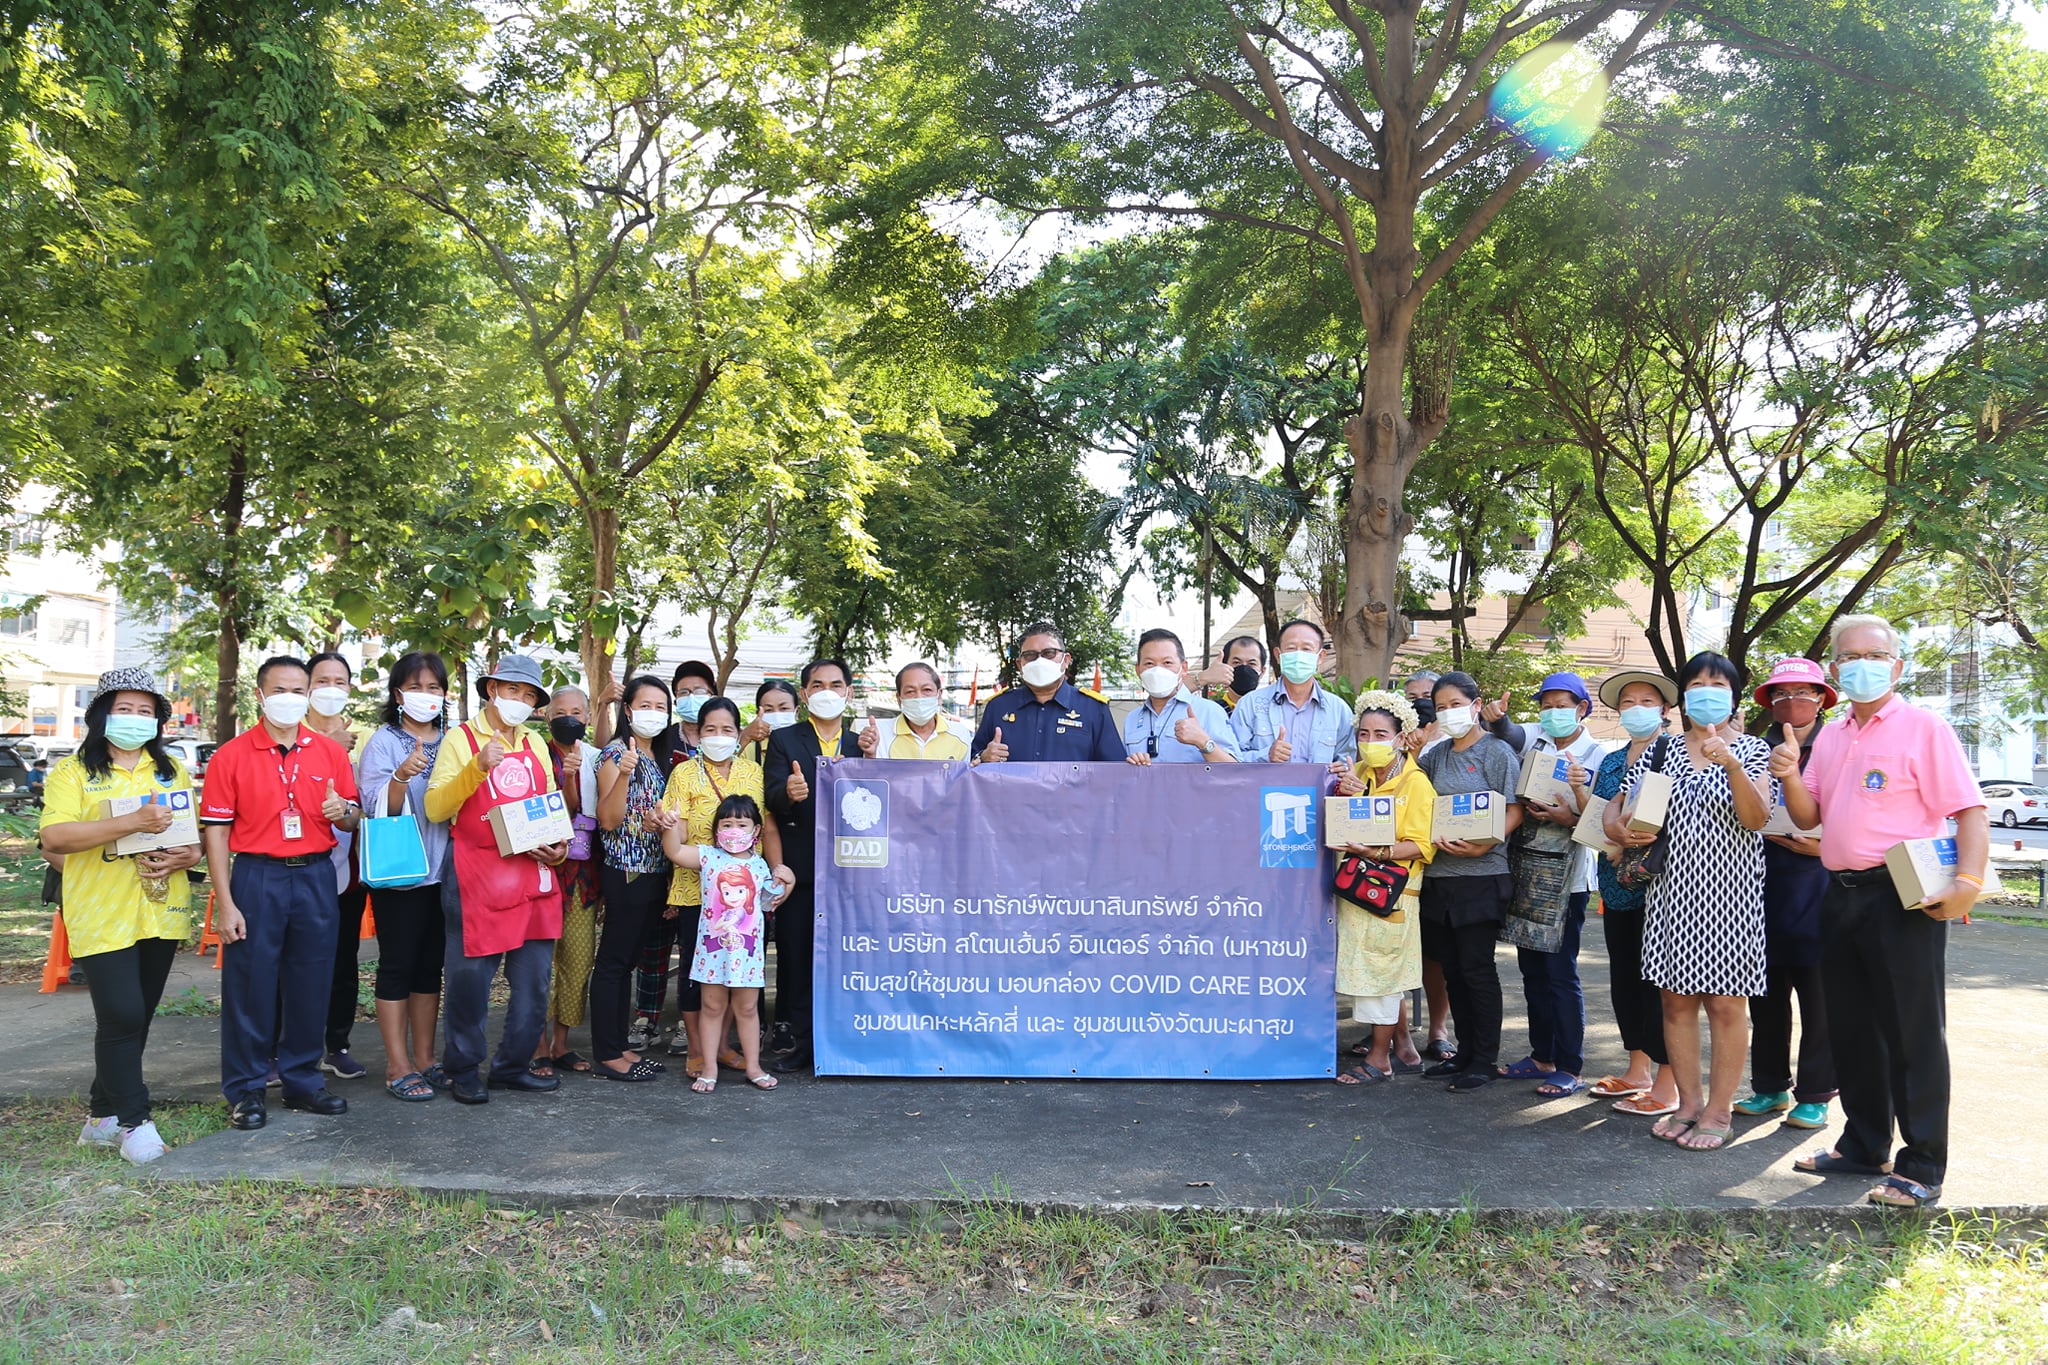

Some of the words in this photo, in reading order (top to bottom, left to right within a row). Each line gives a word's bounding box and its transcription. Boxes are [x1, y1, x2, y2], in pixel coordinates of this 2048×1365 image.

[84, 785, 112, 793] YAMAHA
[840, 840, 882, 857] DAD
[886, 892, 945, 914] บริษัท
[953, 893, 1199, 917] ธนารักษ์พัฒนาสินทรัพย์
[1206, 894, 1263, 917] จำกัด
[842, 935, 880, 952] และ
[888, 931, 947, 953] บริษัท
[954, 931, 1062, 954] สโตนเฮ้นจ์
[1069, 933, 1150, 955] อินเตอร์
[1158, 933, 1214, 956] จำกัด
[1223, 935, 1308, 959] (มหาชน)
[842, 969, 990, 998] เติมสุขให้ชุมชน
[998, 971, 1102, 994] มอบกล่อง
[1109, 974, 1182, 994] COVID
[1189, 975, 1251, 996] CARE
[1259, 976, 1307, 996] BOX
[853, 1005, 1019, 1036] ชุมชนเคหะหลักสี่
[1027, 1015, 1065, 1033] และ
